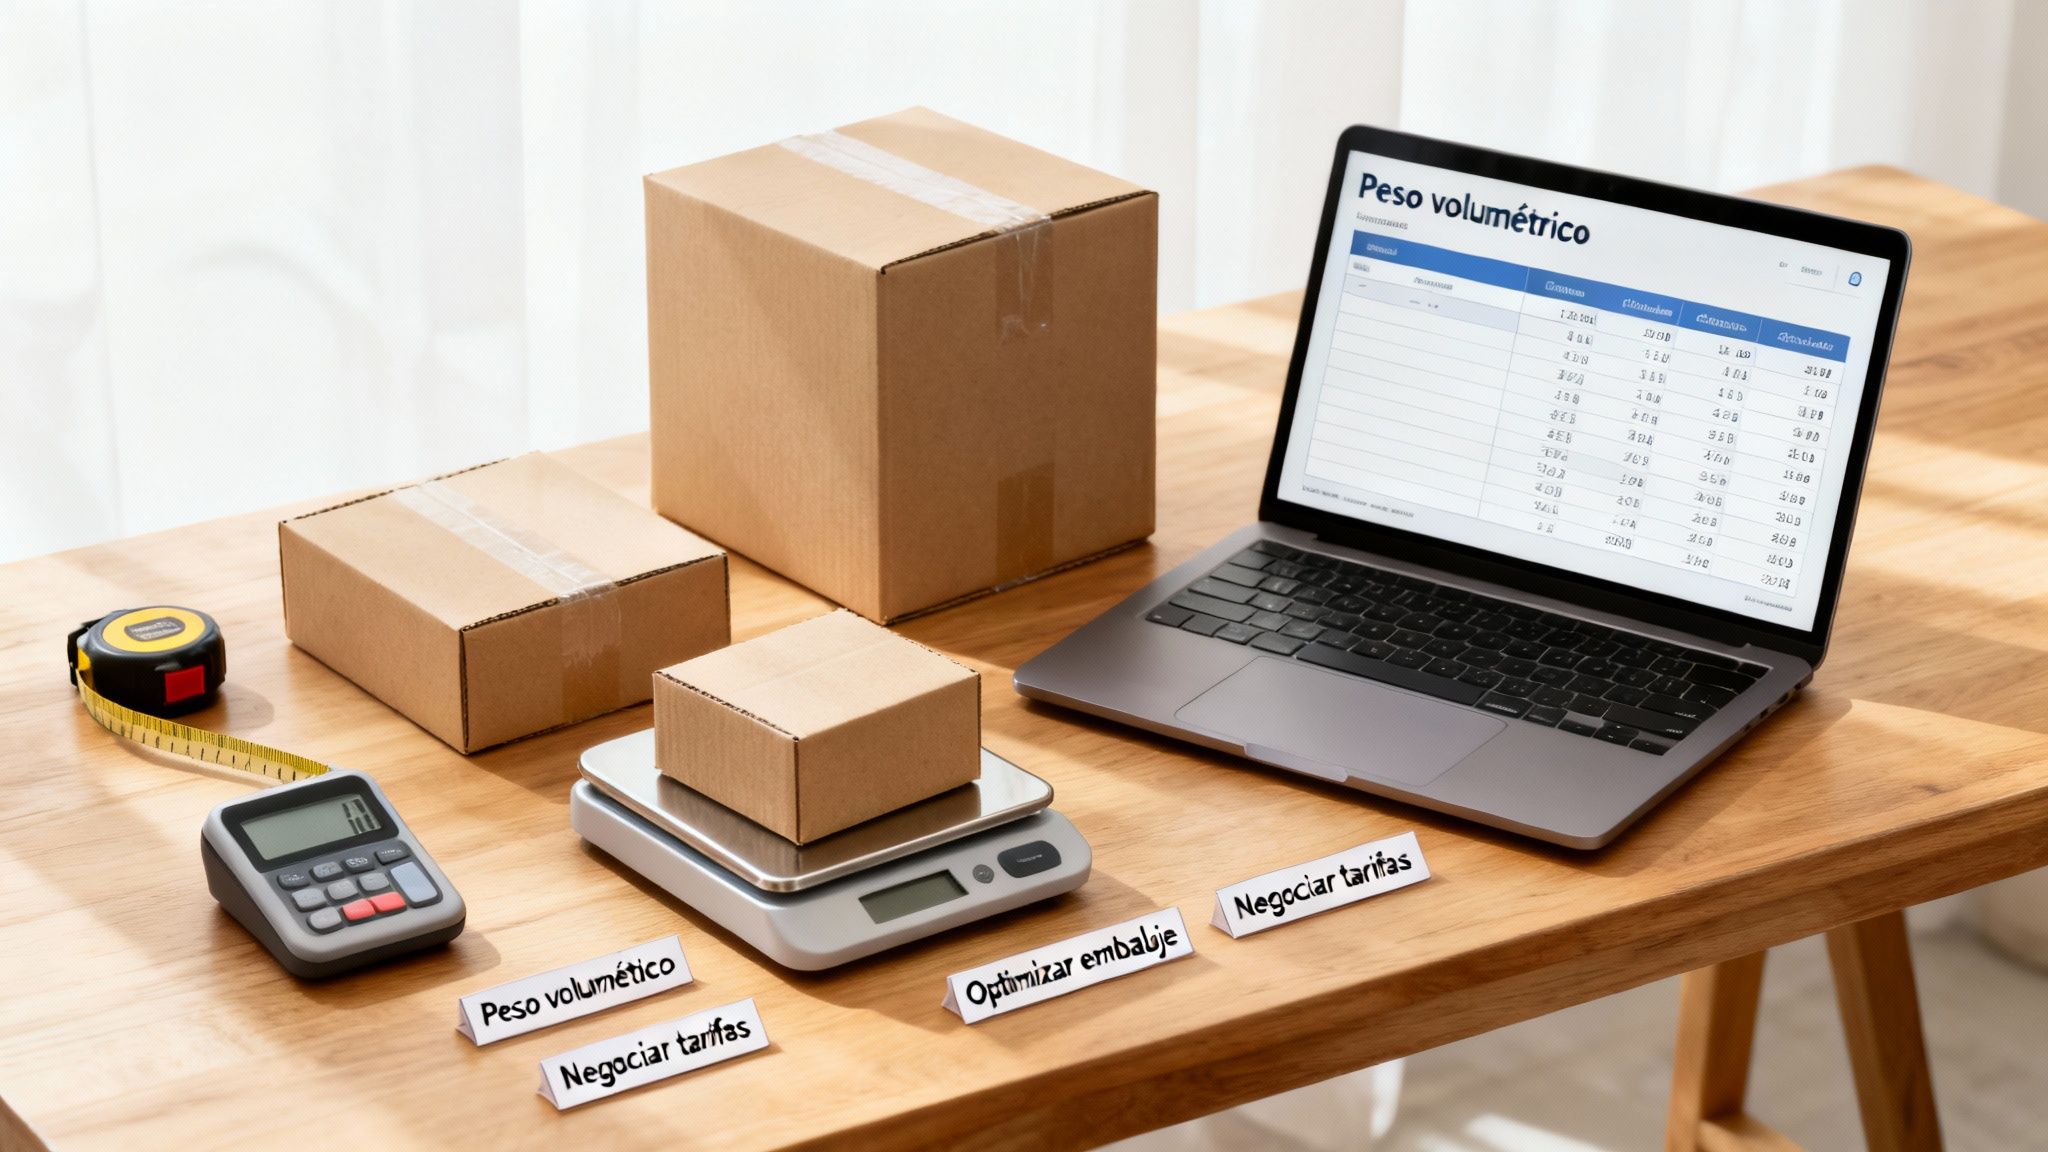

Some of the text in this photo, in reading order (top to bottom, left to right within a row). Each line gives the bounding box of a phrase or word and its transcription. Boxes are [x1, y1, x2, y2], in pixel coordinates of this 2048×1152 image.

[1358, 172, 1424, 209] Peso
[1432, 192, 1591, 245] volumétrico
[1234, 874, 1336, 919] Negociar
[480, 997, 541, 1027] Peso
[559, 1041, 670, 1088] Negociar
